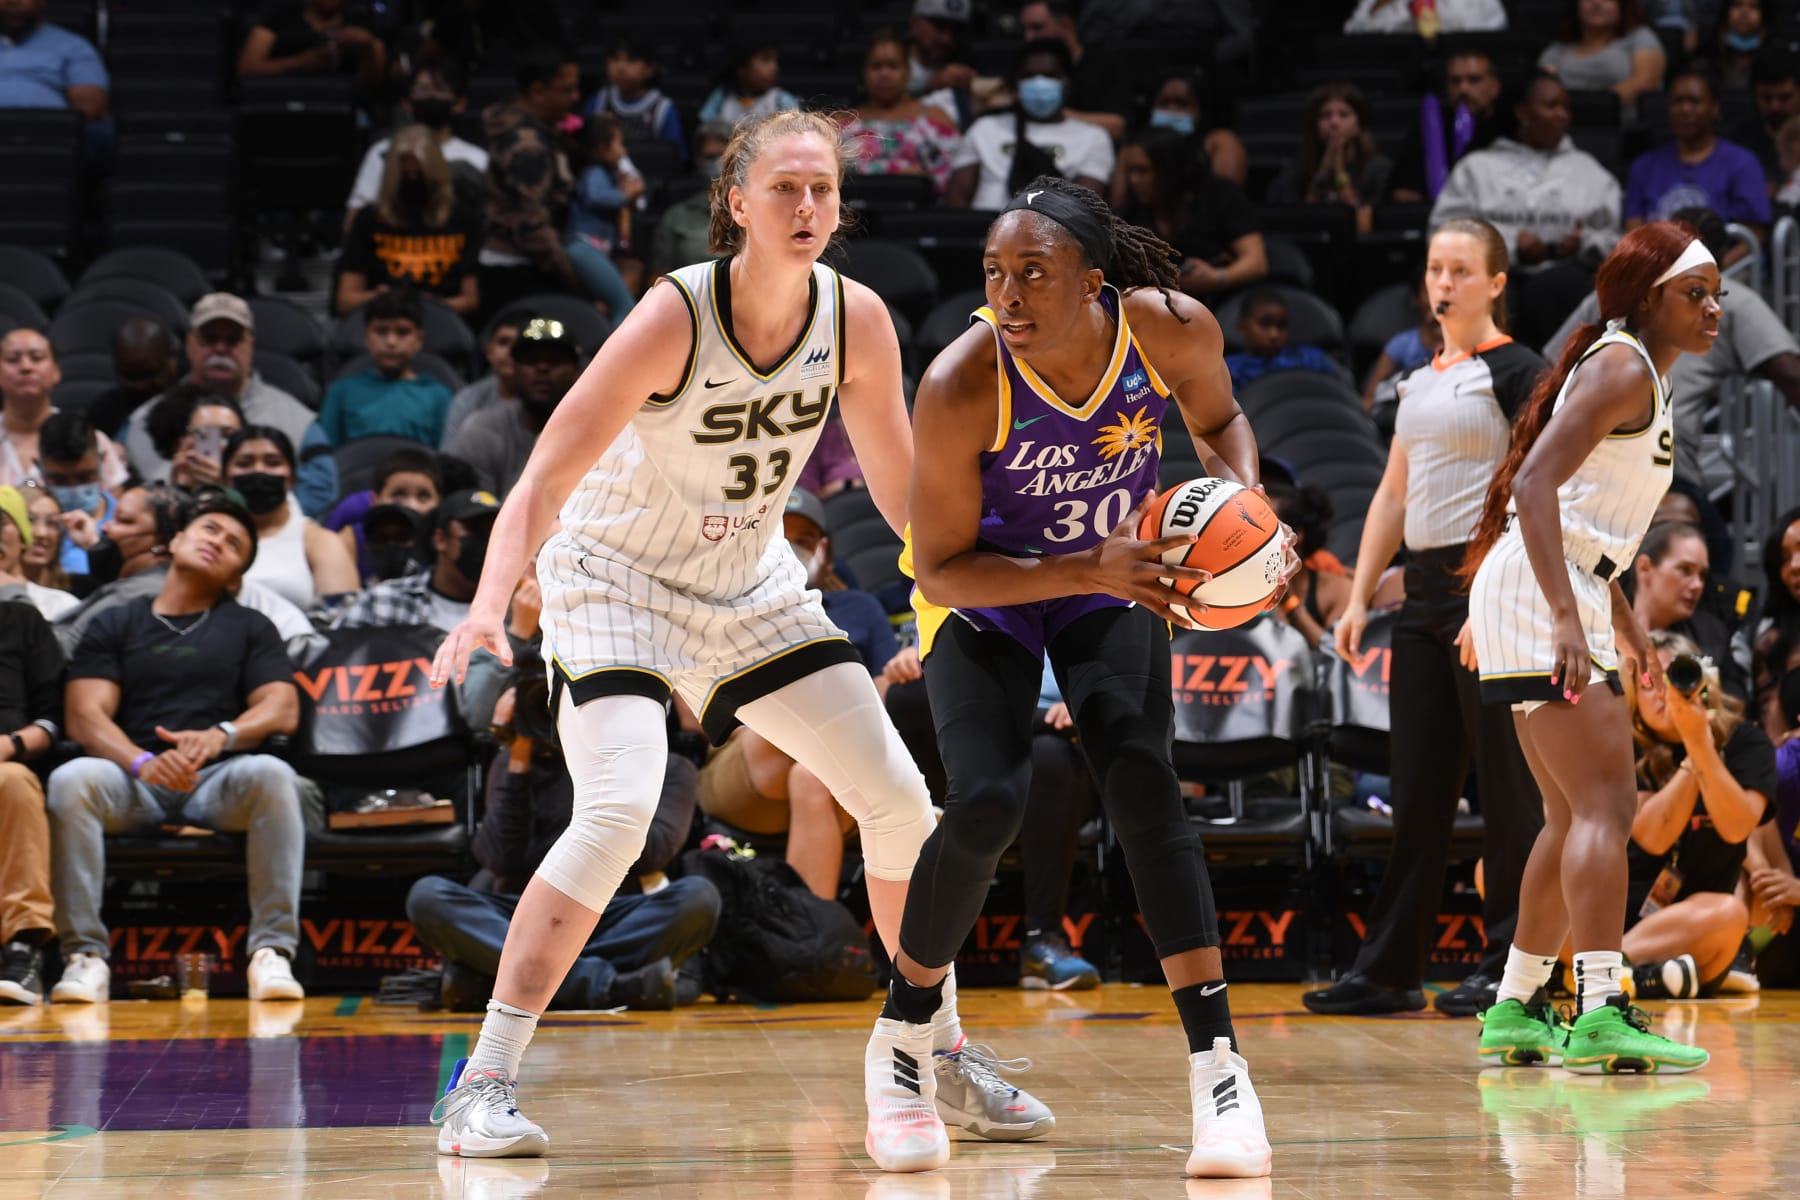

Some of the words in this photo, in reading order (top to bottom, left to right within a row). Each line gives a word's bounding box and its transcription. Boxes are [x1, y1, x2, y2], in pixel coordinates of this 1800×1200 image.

[1126, 385, 1150, 404] Health
[690, 383, 833, 446] SKY
[721, 447, 793, 502] 33
[1005, 440, 1080, 470] LOS
[1043, 488, 1131, 542] 30
[1169, 478, 1227, 528] Wilso
[1171, 653, 1289, 692] IZZY
[316, 703, 364, 715] HARD
[300, 918, 422, 955] VIZZ
